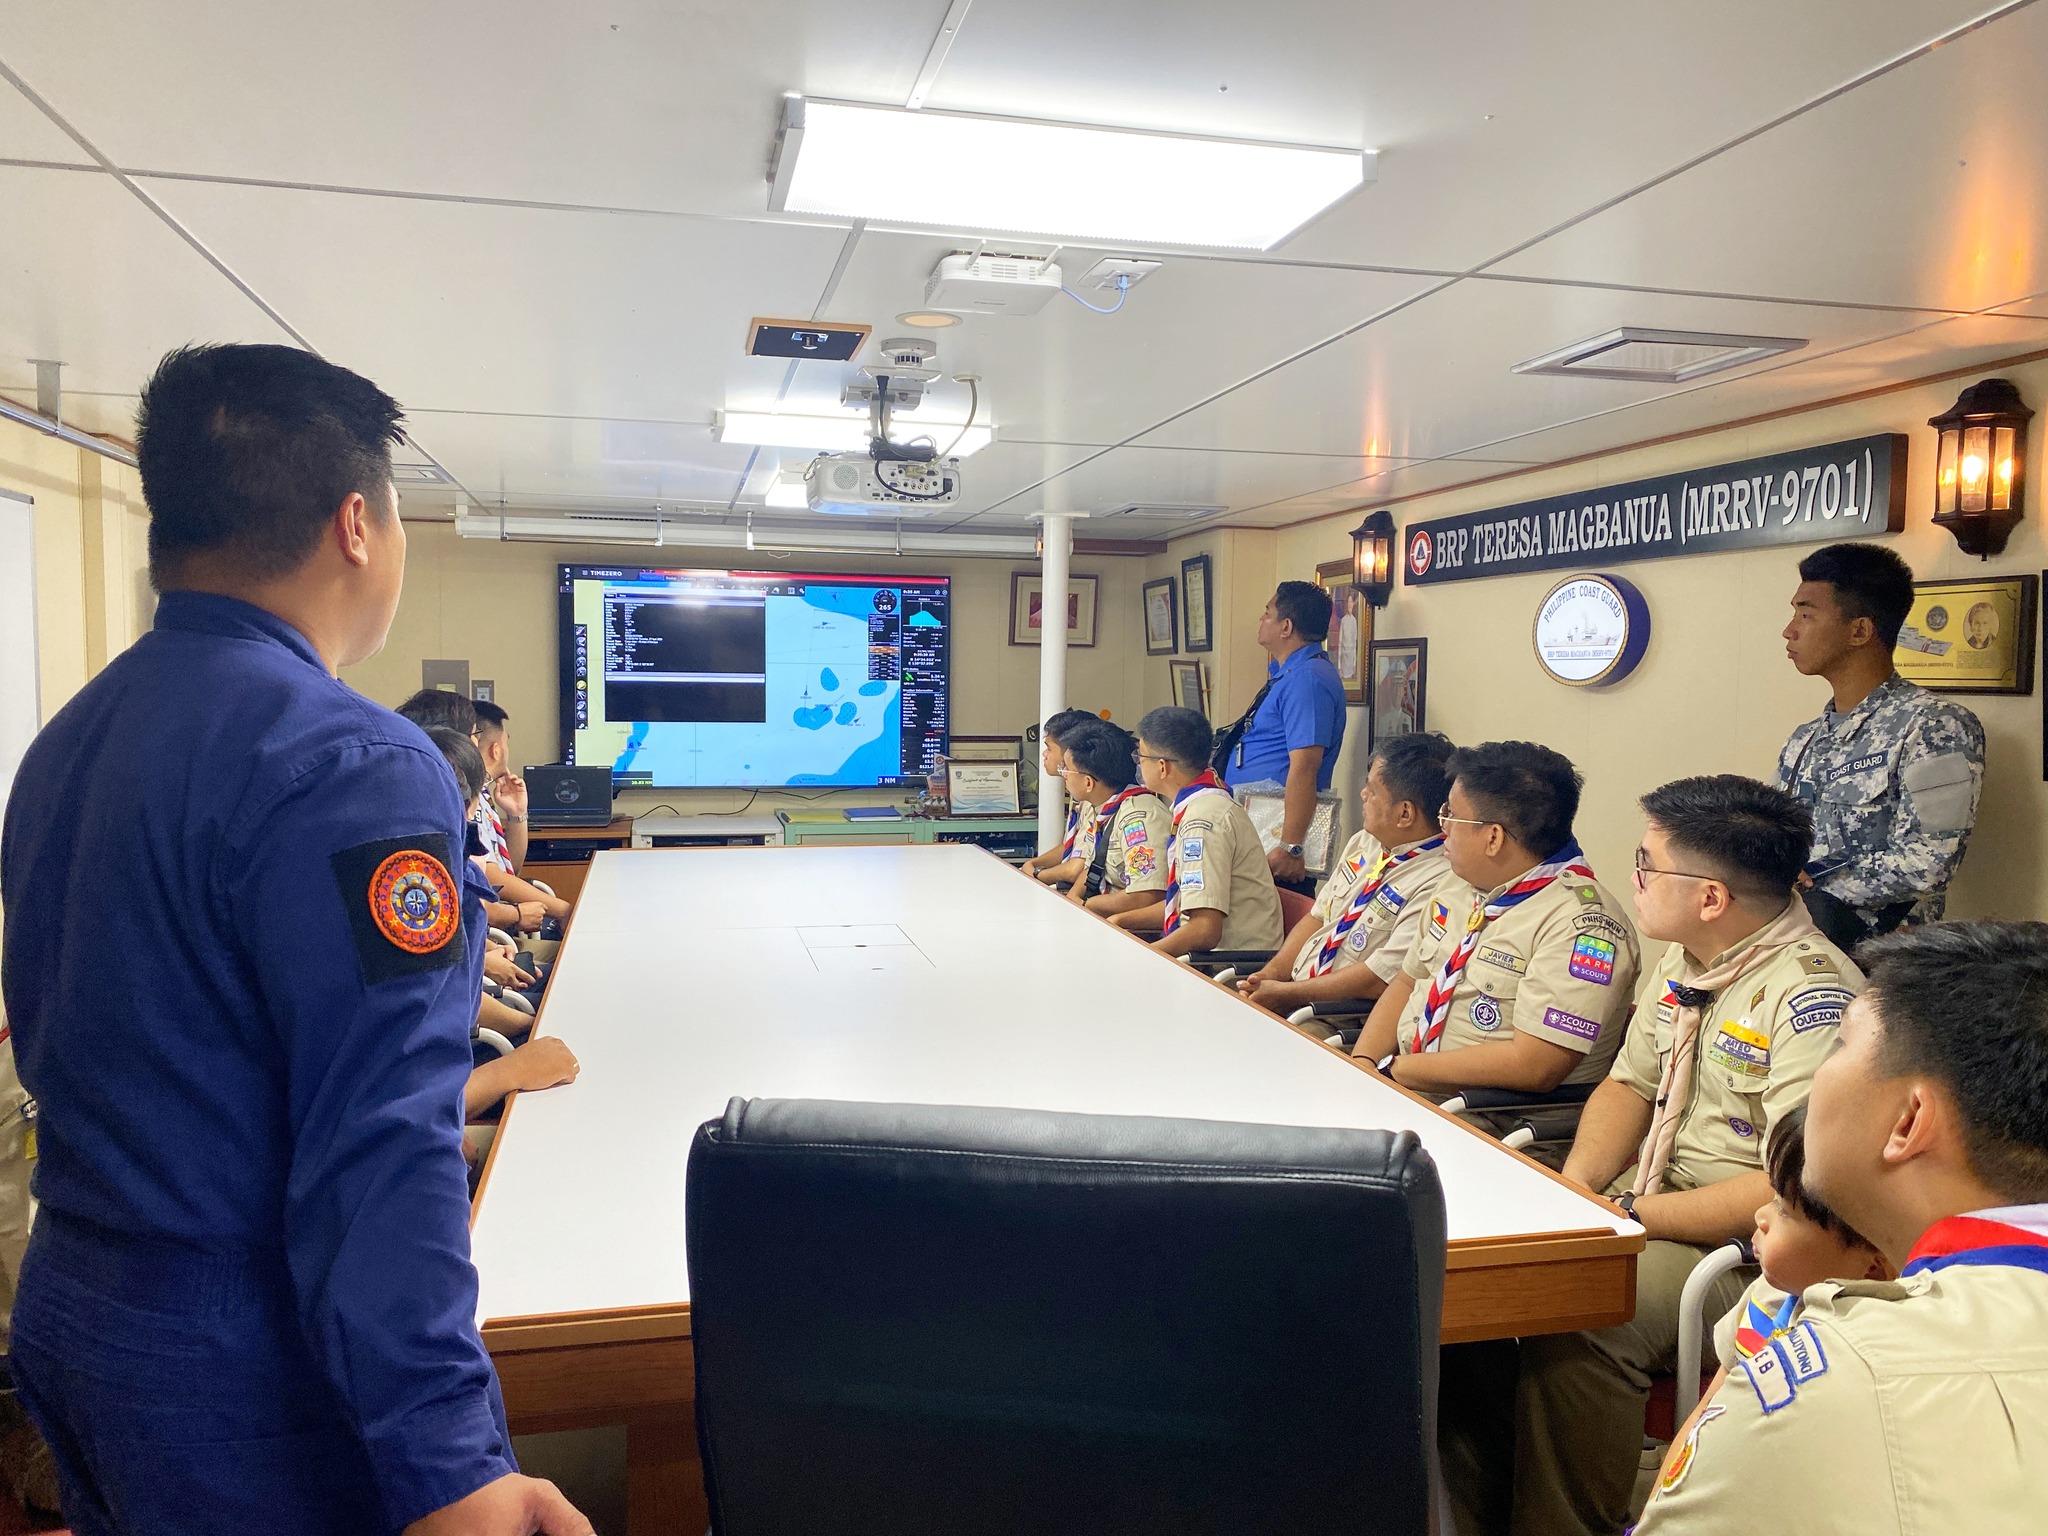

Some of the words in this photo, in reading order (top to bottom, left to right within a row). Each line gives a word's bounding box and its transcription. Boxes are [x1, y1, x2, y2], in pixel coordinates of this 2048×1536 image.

[1435, 528, 1468, 570] BRP
[1472, 514, 1543, 564] TERESA
[1547, 492, 1673, 555] MAGBANUA
[1680, 447, 1873, 545] (MRRV-9701)
[1543, 587, 1576, 623] PHILIPPINE
[1579, 585, 1601, 599] COAST
[1601, 590, 1622, 618] GUARD
[1830, 763, 1851, 780] COAST
[1853, 755, 1883, 770] GUARD
[1581, 915, 1622, 934] PNHS-MAIN
[1576, 945, 1613, 961] FROM
[1579, 936, 1614, 953] SAFE
[1488, 951, 1515, 963] JAVIER
[1573, 954, 1611, 971] HARM
[1580, 968, 1608, 981] SCOUTS
[1560, 1014, 1598, 1032] SCOUTS
[1796, 1010, 1841, 1027] QUEZON
